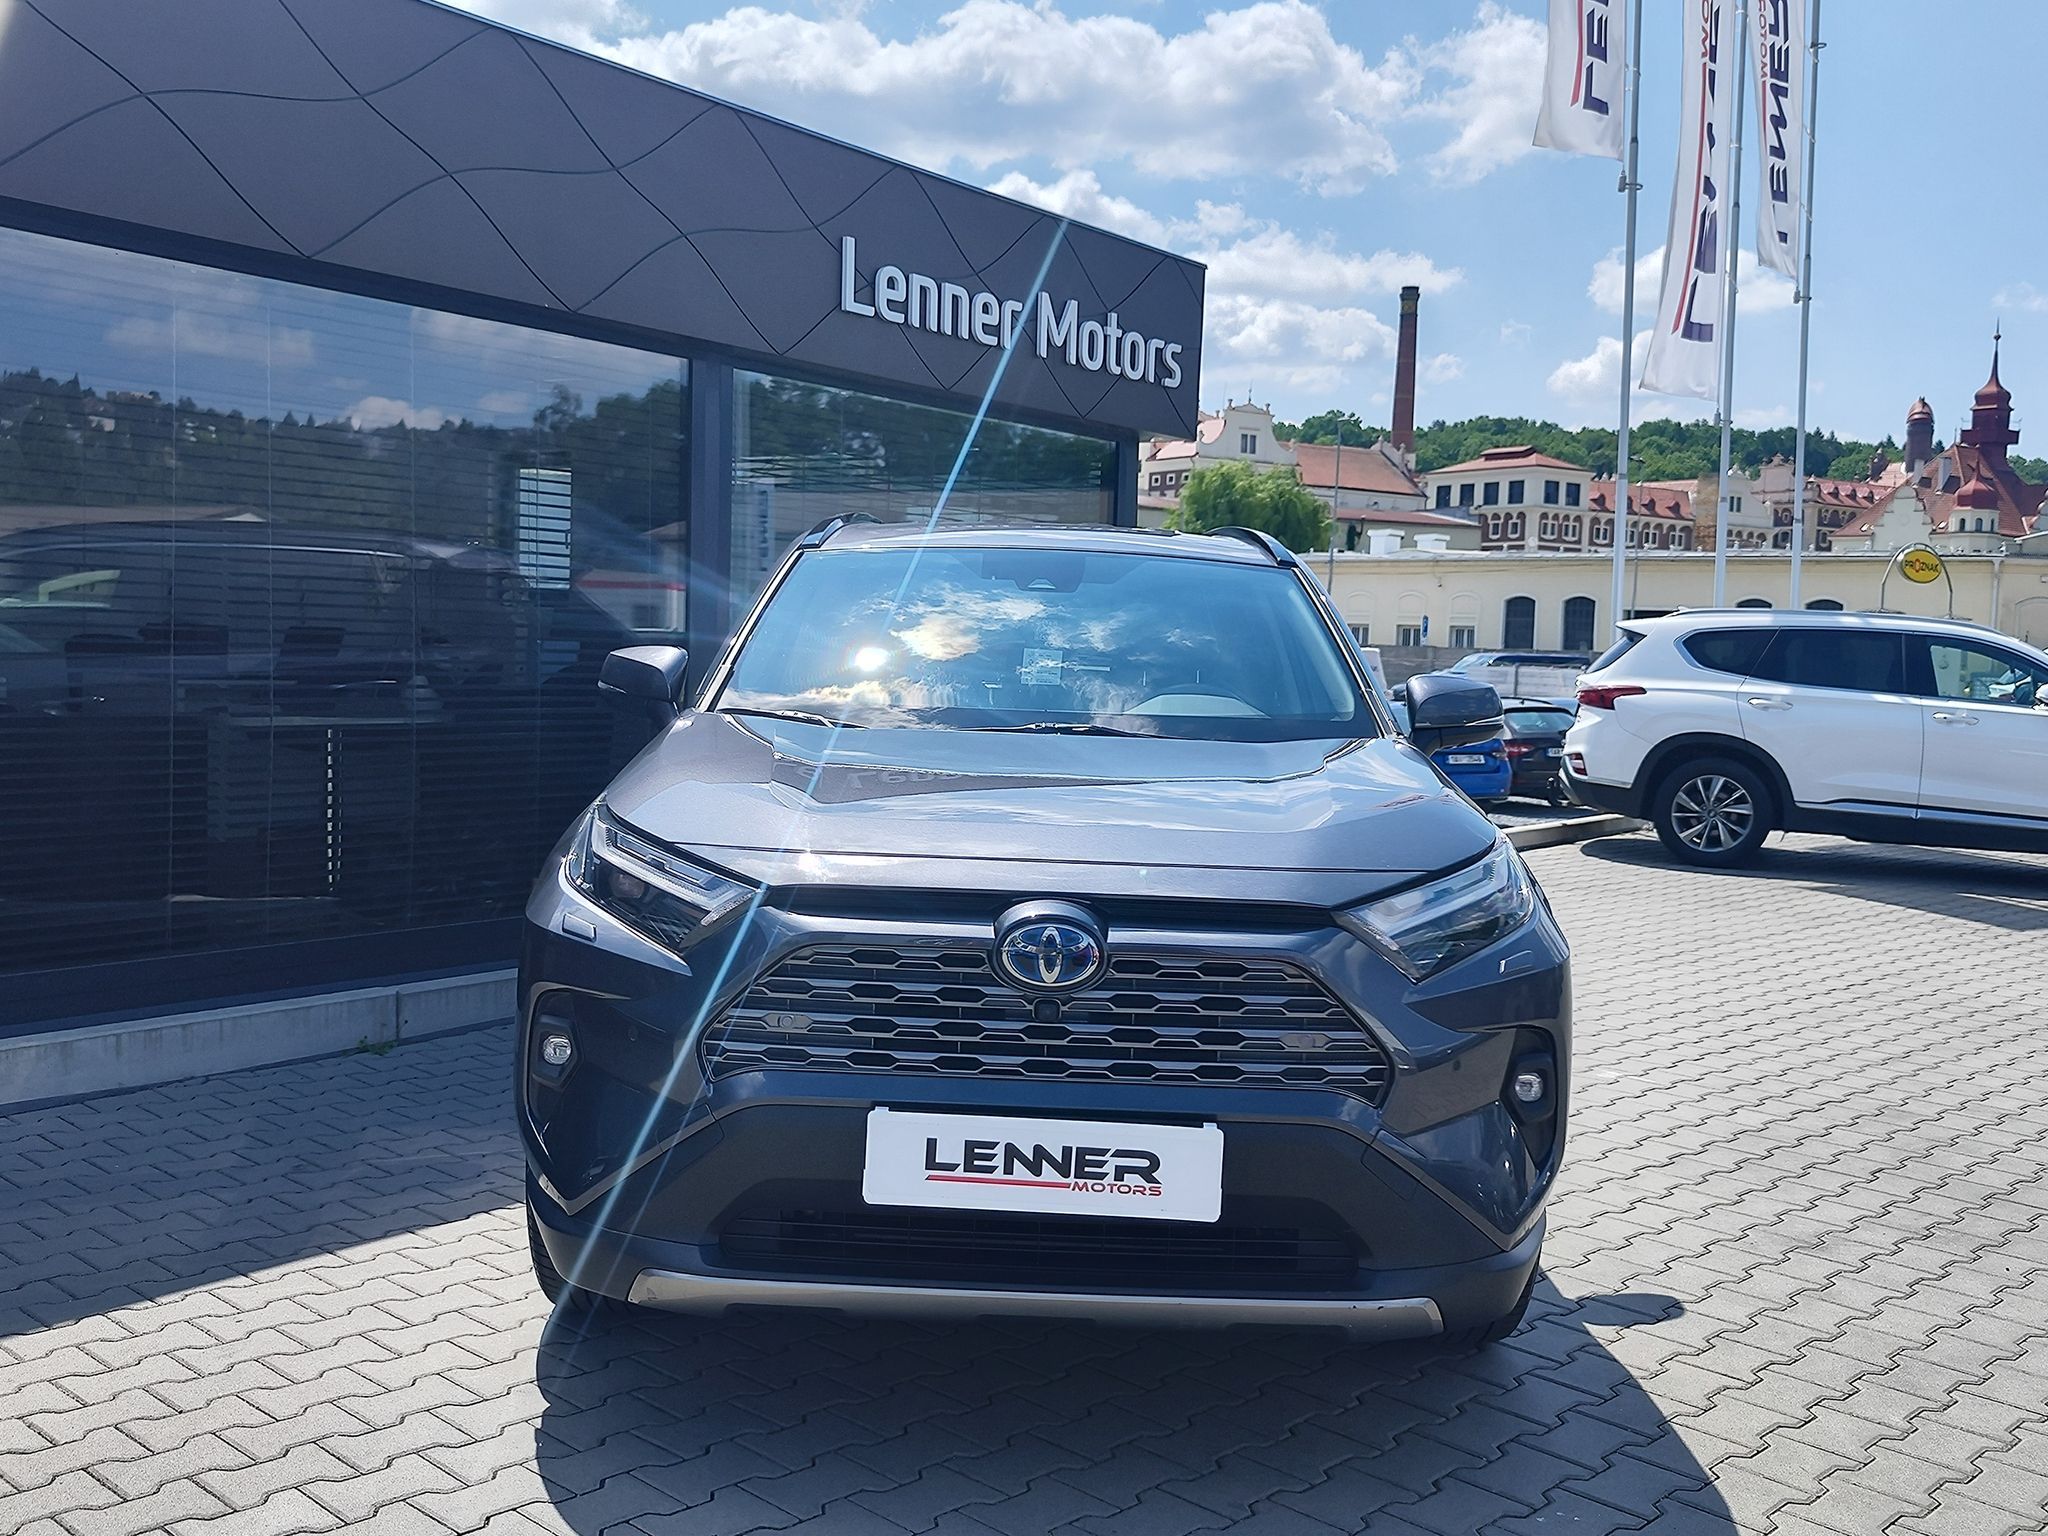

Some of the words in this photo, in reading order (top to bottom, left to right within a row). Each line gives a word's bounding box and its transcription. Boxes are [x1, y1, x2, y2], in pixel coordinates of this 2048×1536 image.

[841, 236, 1023, 350] Lenner
[1036, 291, 1183, 388] Motors
[924, 1137, 1162, 1185] LENNER
[1071, 1181, 1163, 1196] MOTORS
